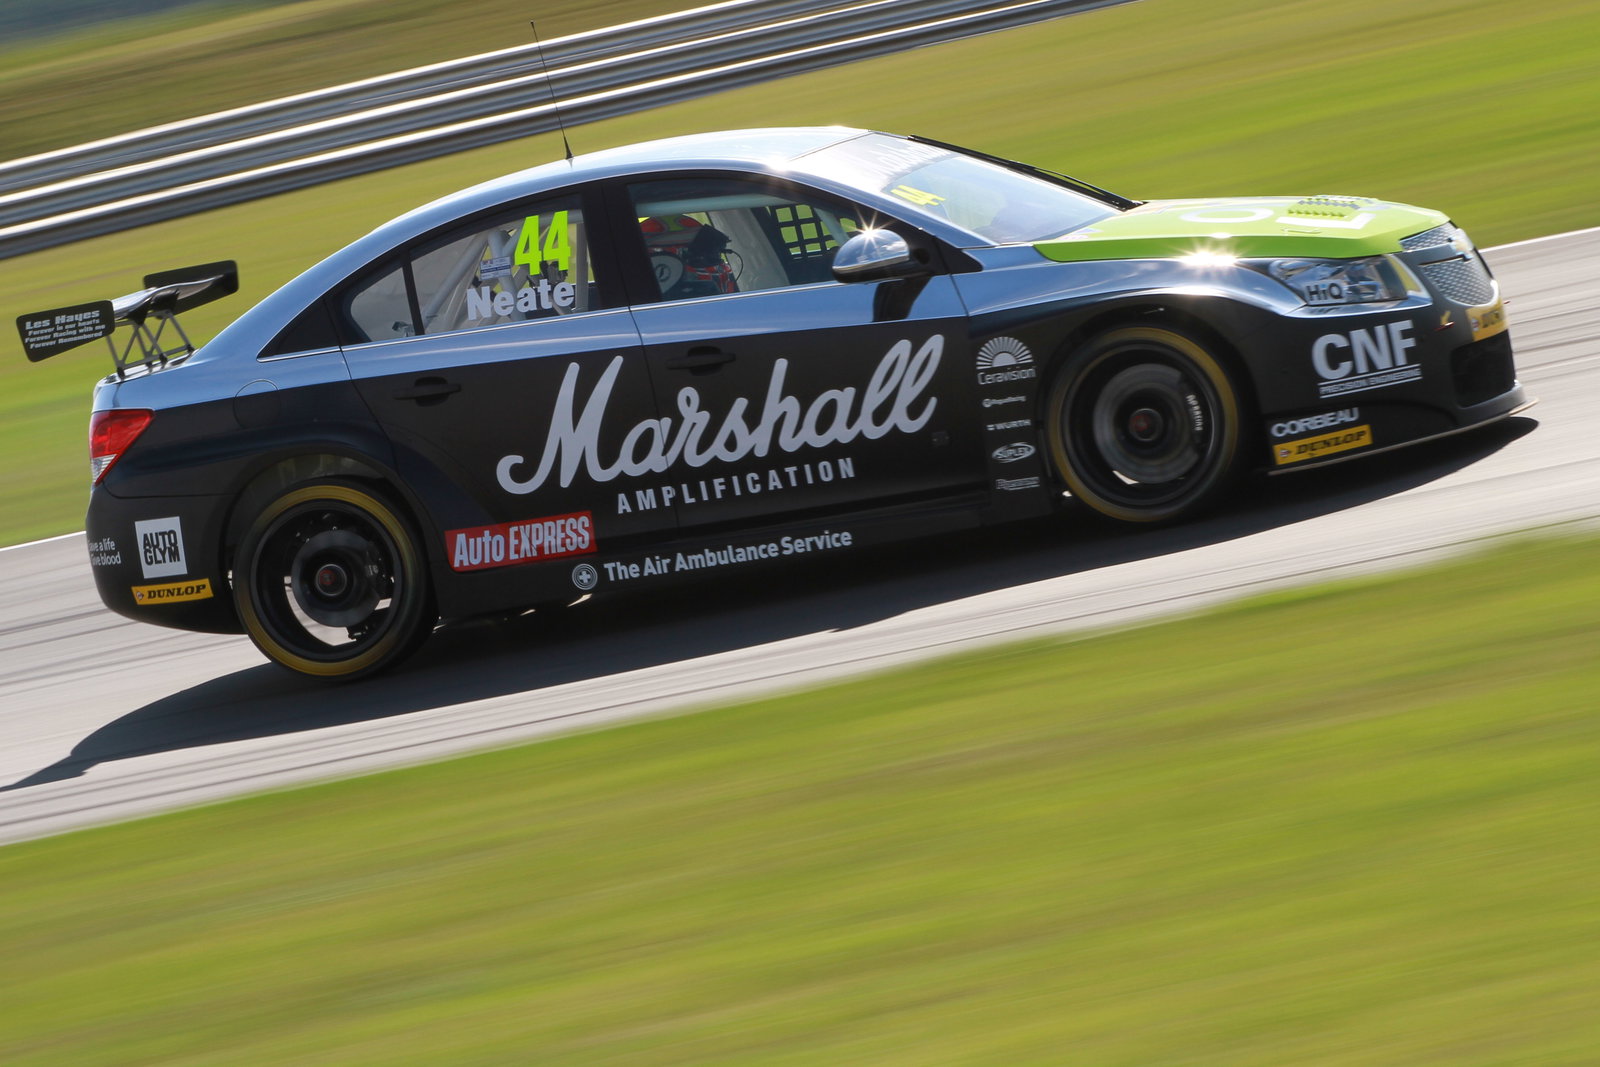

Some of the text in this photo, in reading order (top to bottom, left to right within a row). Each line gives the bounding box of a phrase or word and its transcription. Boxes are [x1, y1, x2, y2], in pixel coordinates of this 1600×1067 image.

[514, 210, 571, 276] 44
[466, 278, 574, 321] Neate
[1305, 281, 1344, 303] HiQ
[25, 310, 100, 330] Les Hayes
[25, 334, 51, 343] Forever
[53, 330, 77, 338] Racing
[28, 327, 55, 336] Forever
[30, 331, 103, 349] Forever Remembered
[1311, 319, 1416, 381] CNF
[977, 368, 1036, 385] Ceravision
[495, 334, 945, 495] Marshall
[1271, 407, 1360, 438] CORBEAU
[1295, 430, 1368, 455] DUNLOP
[617, 457, 855, 514] AMPLIFICATION
[103, 537, 116, 551] life
[143, 529, 178, 550] AUTO
[453, 515, 590, 568] Auto EXPRESS
[100, 551, 122, 566] blood
[144, 545, 181, 566] GLYM
[603, 530, 852, 582] The Air Ambulance Service
[147, 583, 206, 599] DUNLOP
